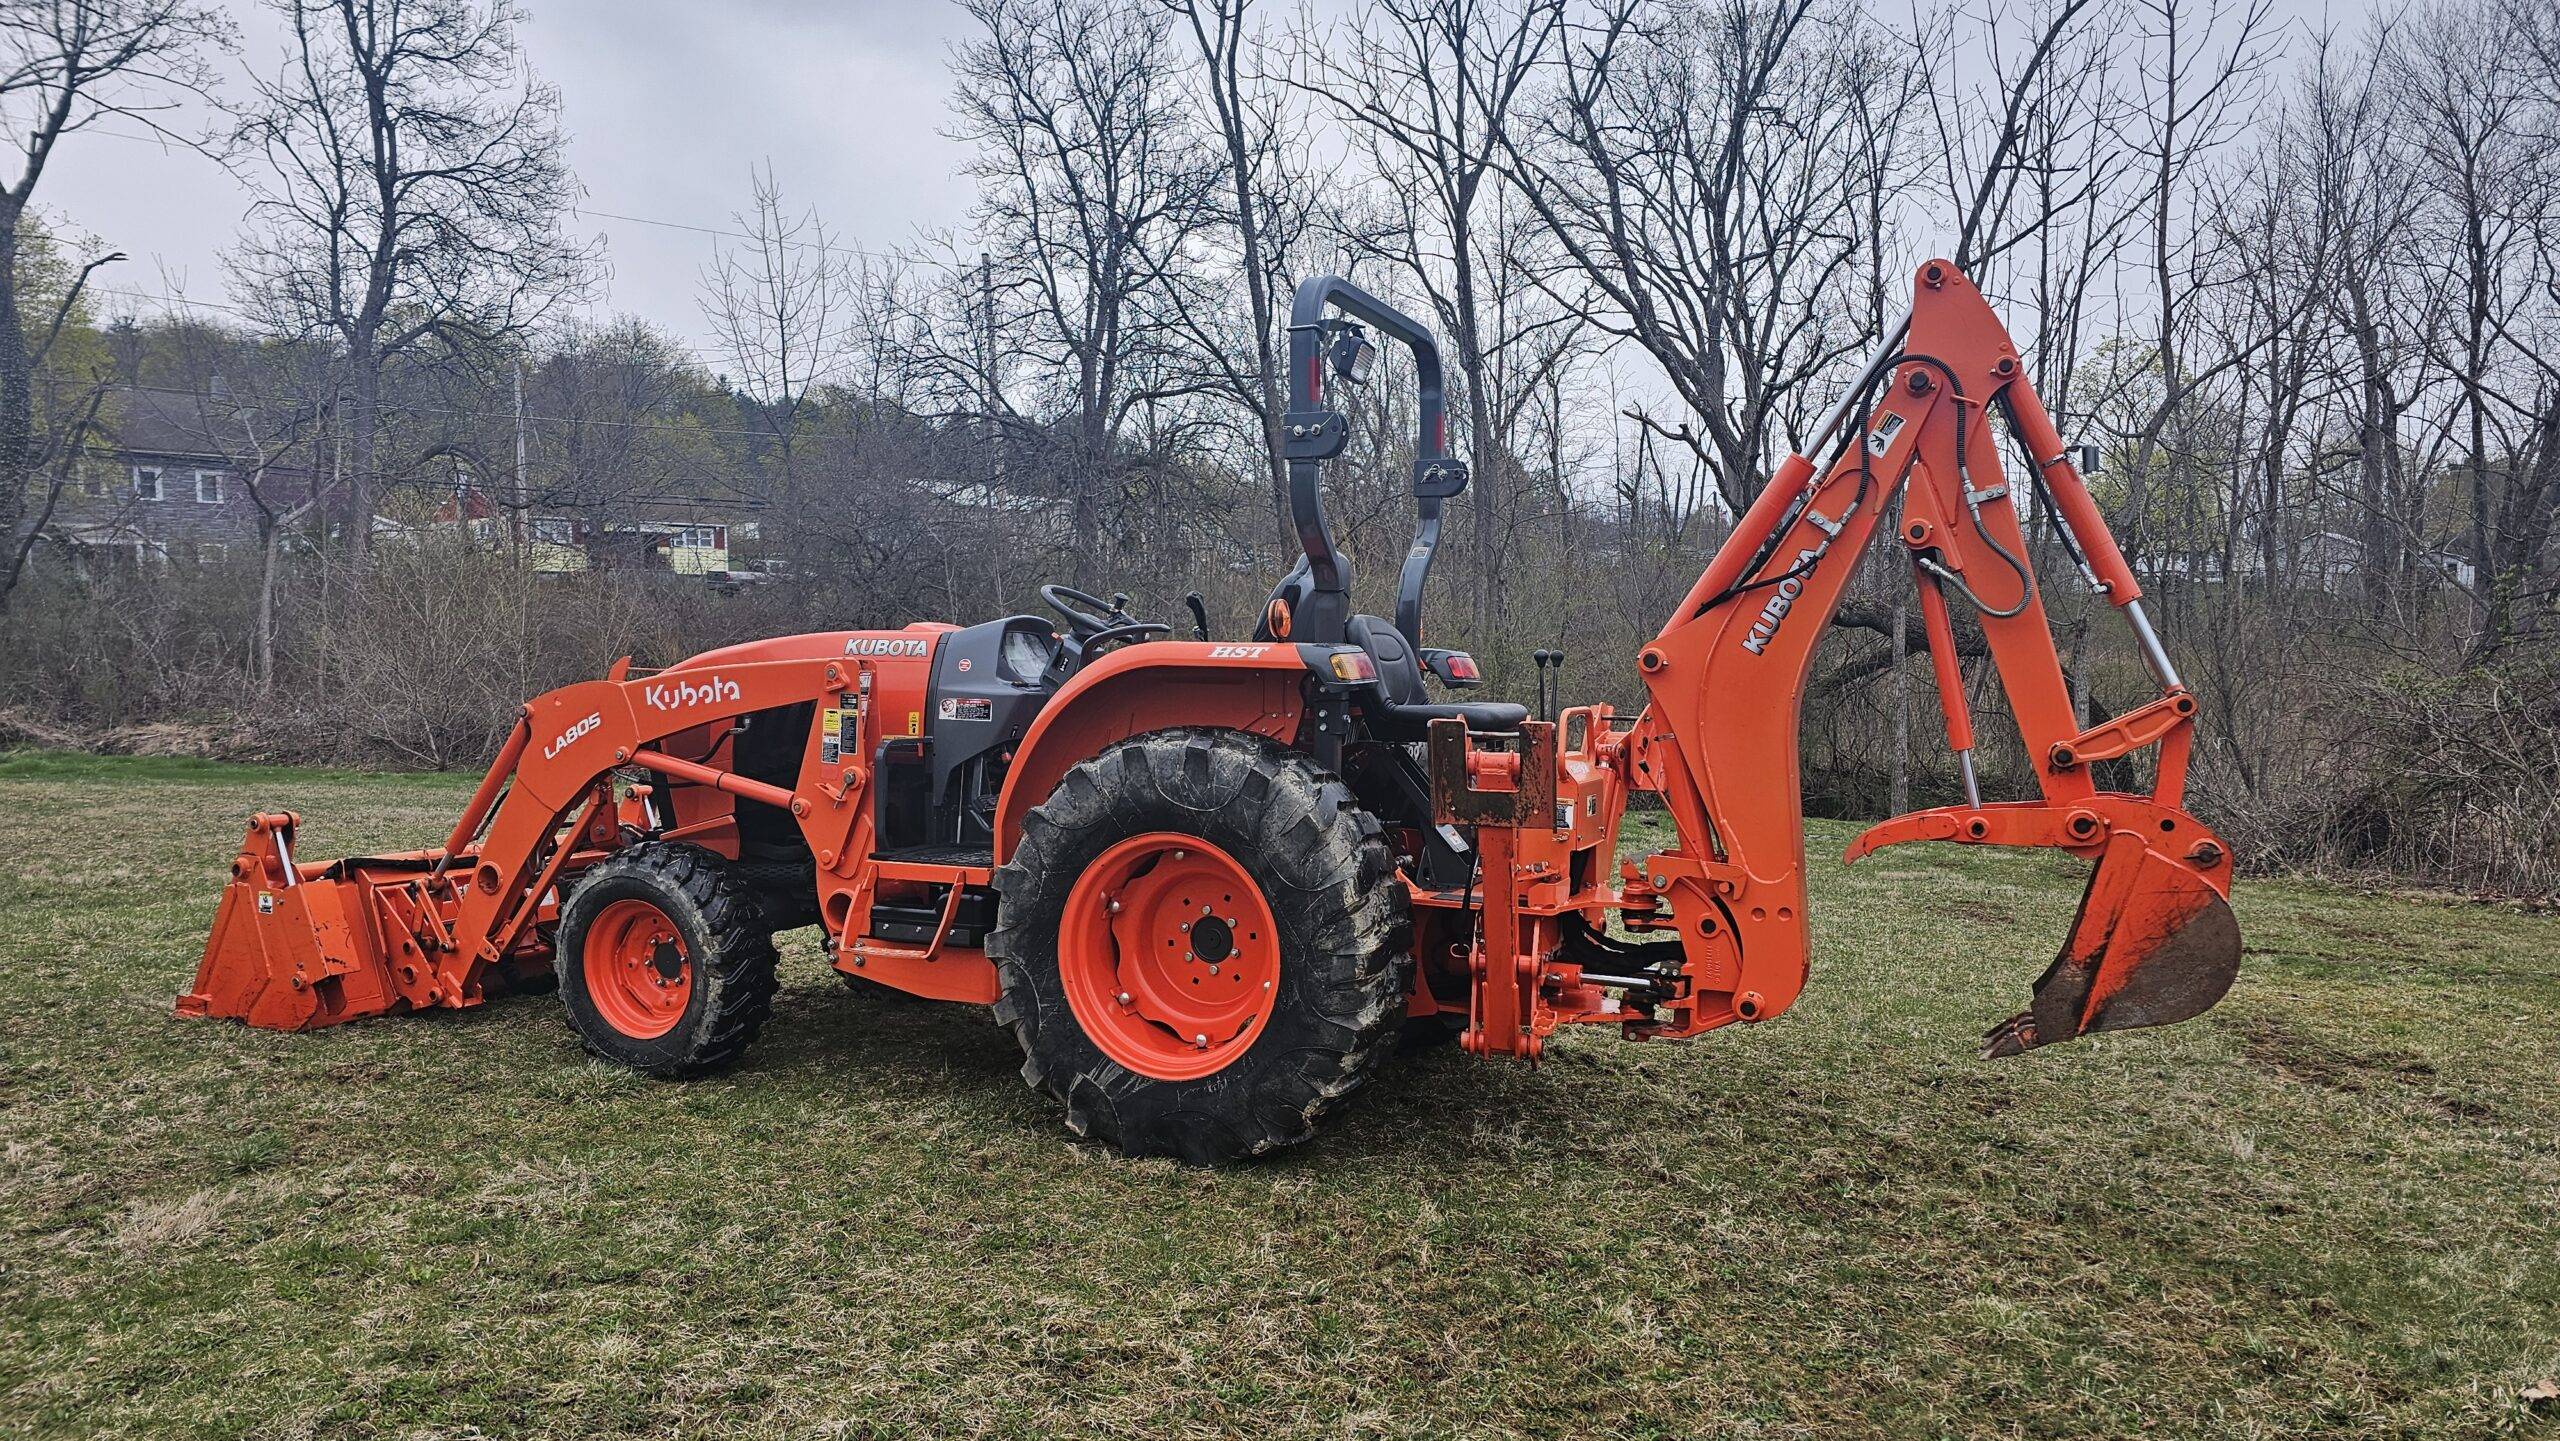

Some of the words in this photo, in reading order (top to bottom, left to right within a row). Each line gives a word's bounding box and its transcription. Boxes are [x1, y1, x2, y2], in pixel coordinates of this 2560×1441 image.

[844, 638, 927, 656] KUBOTA
[1207, 646, 1270, 658] HST
[645, 675, 741, 711] Kubota
[543, 711, 601, 760] LA805
